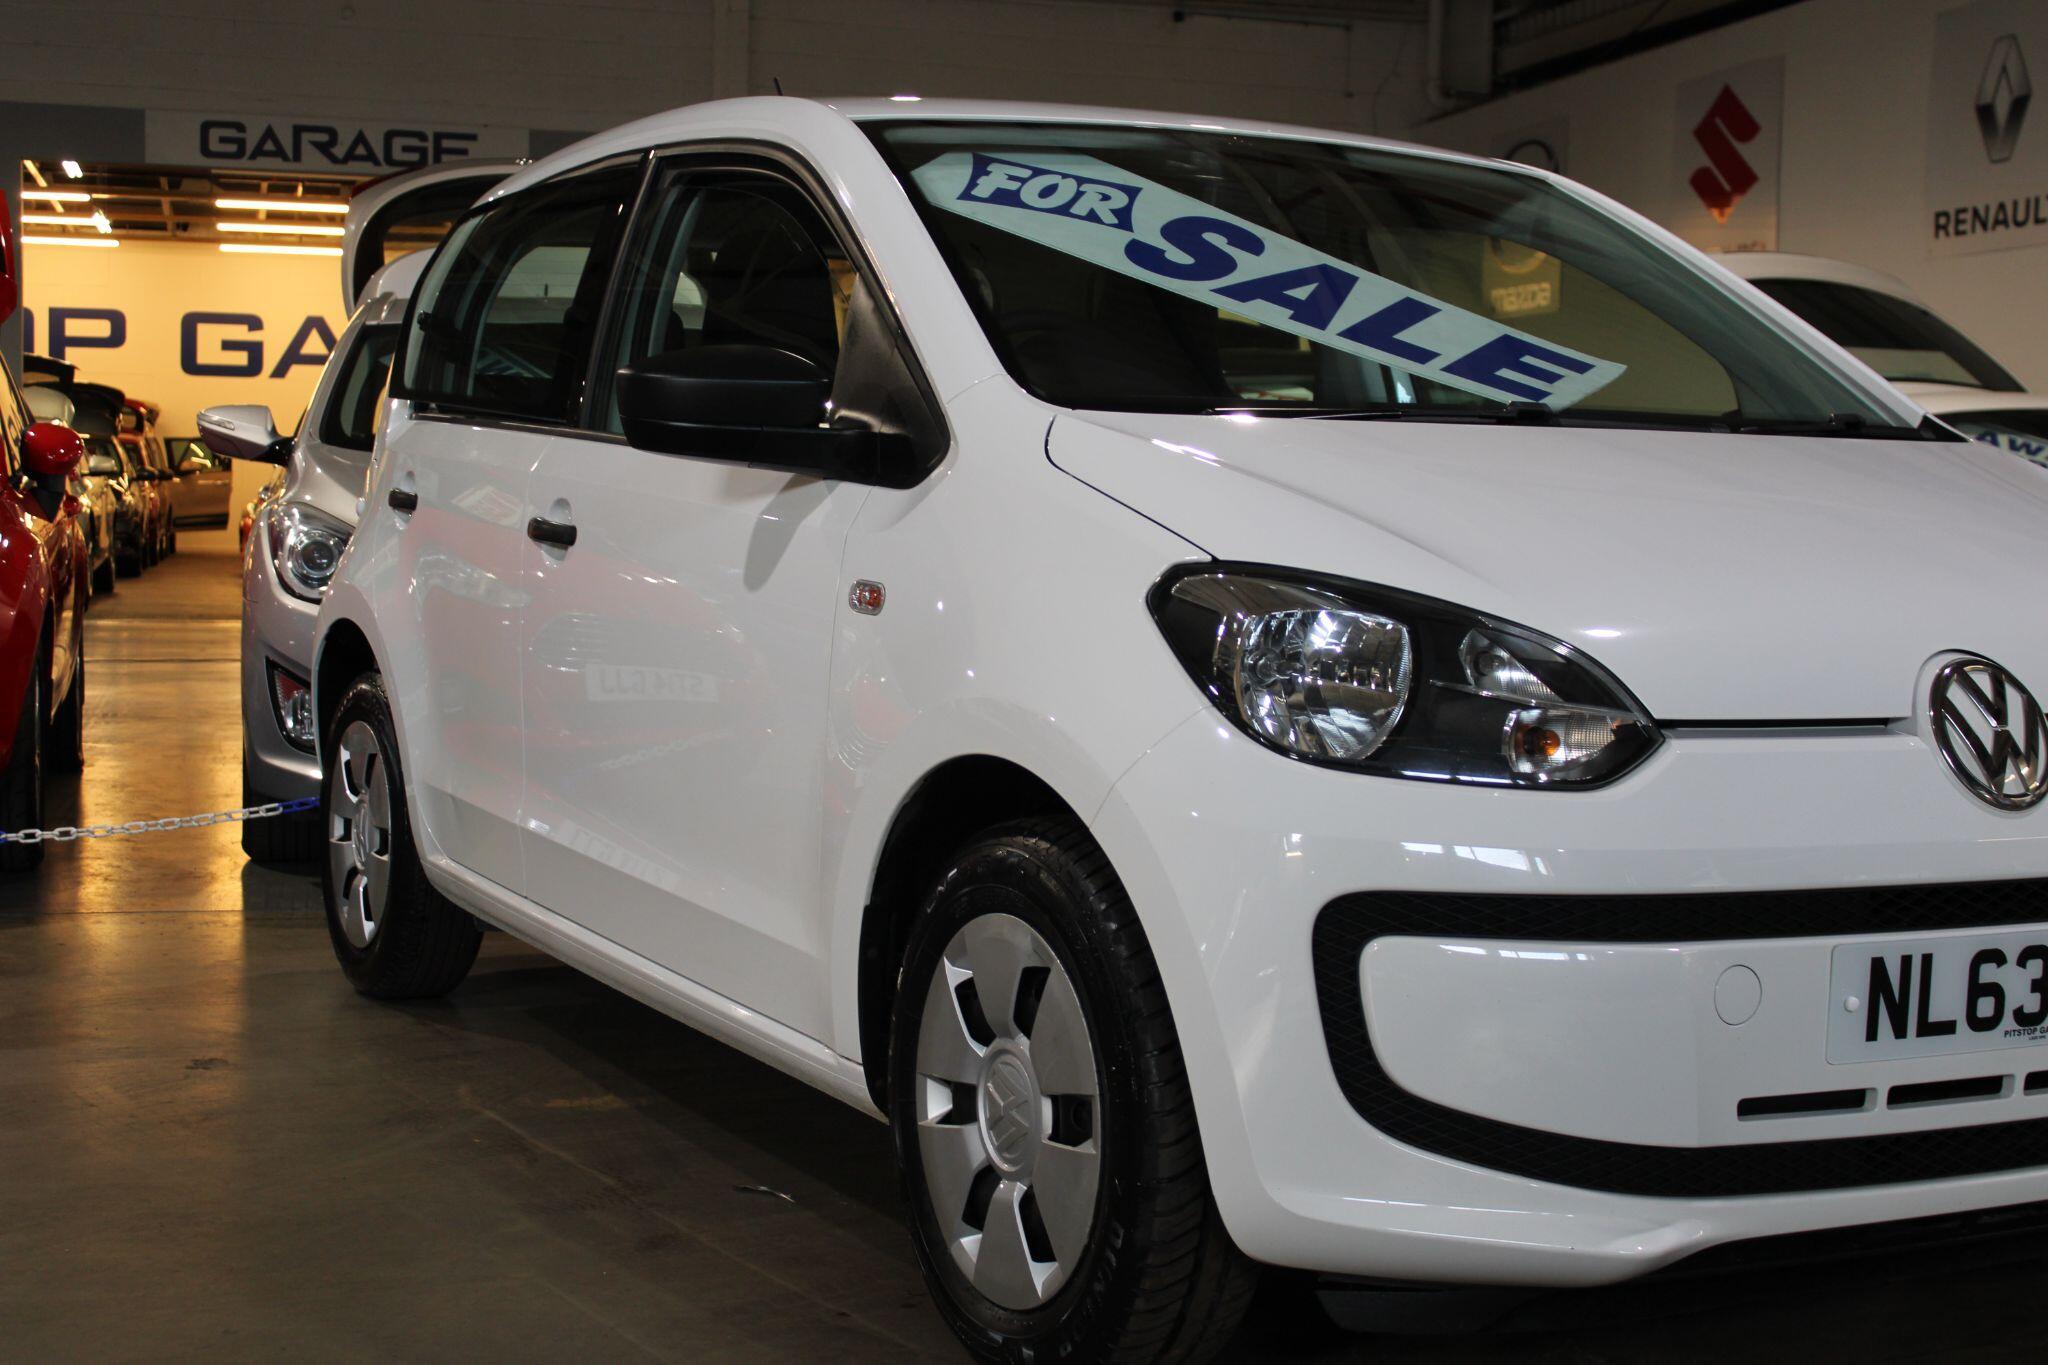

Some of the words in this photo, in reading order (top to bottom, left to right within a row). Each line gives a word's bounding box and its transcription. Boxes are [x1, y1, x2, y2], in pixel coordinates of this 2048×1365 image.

[200, 120, 478, 168] GARAGE
[1934, 193, 2048, 239] RENAUL
[970, 162, 1130, 225] FOR
[1124, 216, 1596, 402] SALE
[23, 307, 126, 361] P
[1865, 944, 2048, 1042] NL63
[2004, 1026, 2038, 1038] PITSTOP
